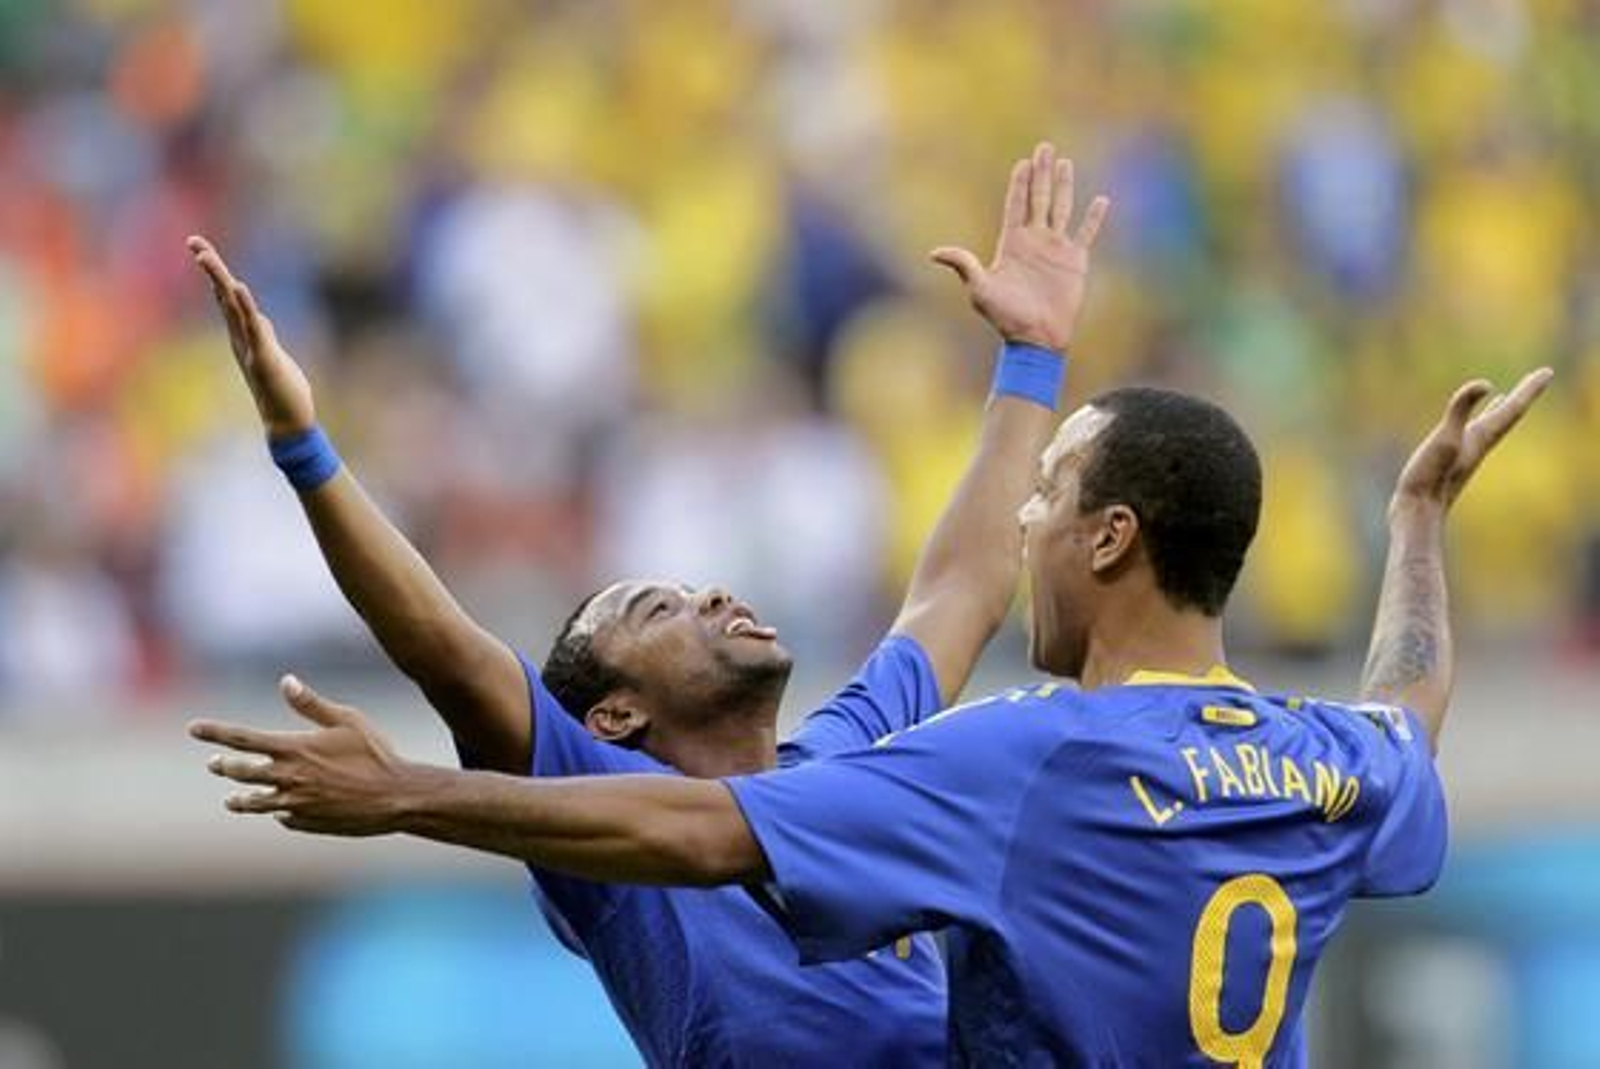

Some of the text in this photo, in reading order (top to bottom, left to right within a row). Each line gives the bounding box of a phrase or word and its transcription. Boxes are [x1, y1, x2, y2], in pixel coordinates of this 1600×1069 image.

[1129, 744, 1360, 825] L. FABIANO
[1189, 873, 1297, 1069] 9
